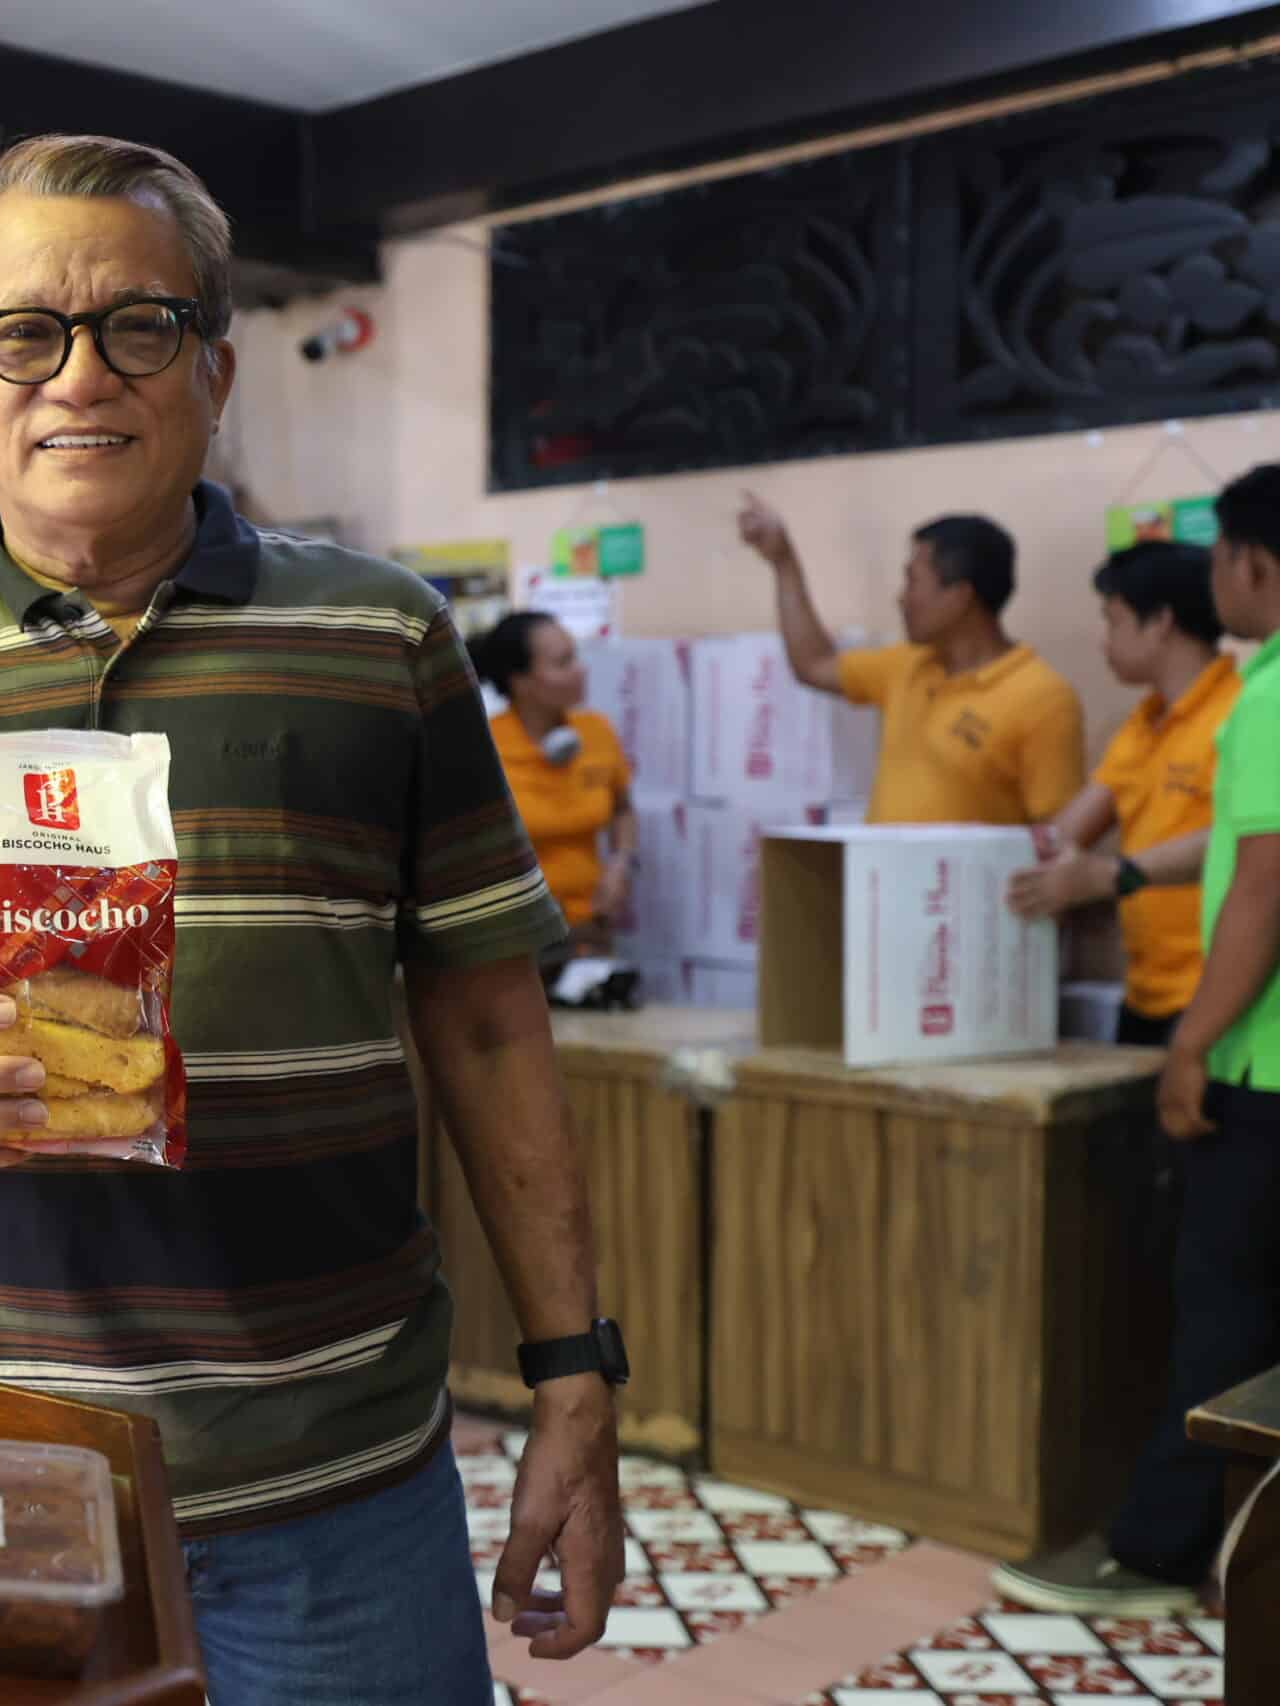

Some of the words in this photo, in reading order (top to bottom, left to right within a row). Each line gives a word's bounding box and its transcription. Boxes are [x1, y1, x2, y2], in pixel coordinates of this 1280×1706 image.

[32, 831, 82, 842] ORIGINAL
[2, 839, 72, 850] BISCOCHO
[75, 842, 111, 855] HAUS
